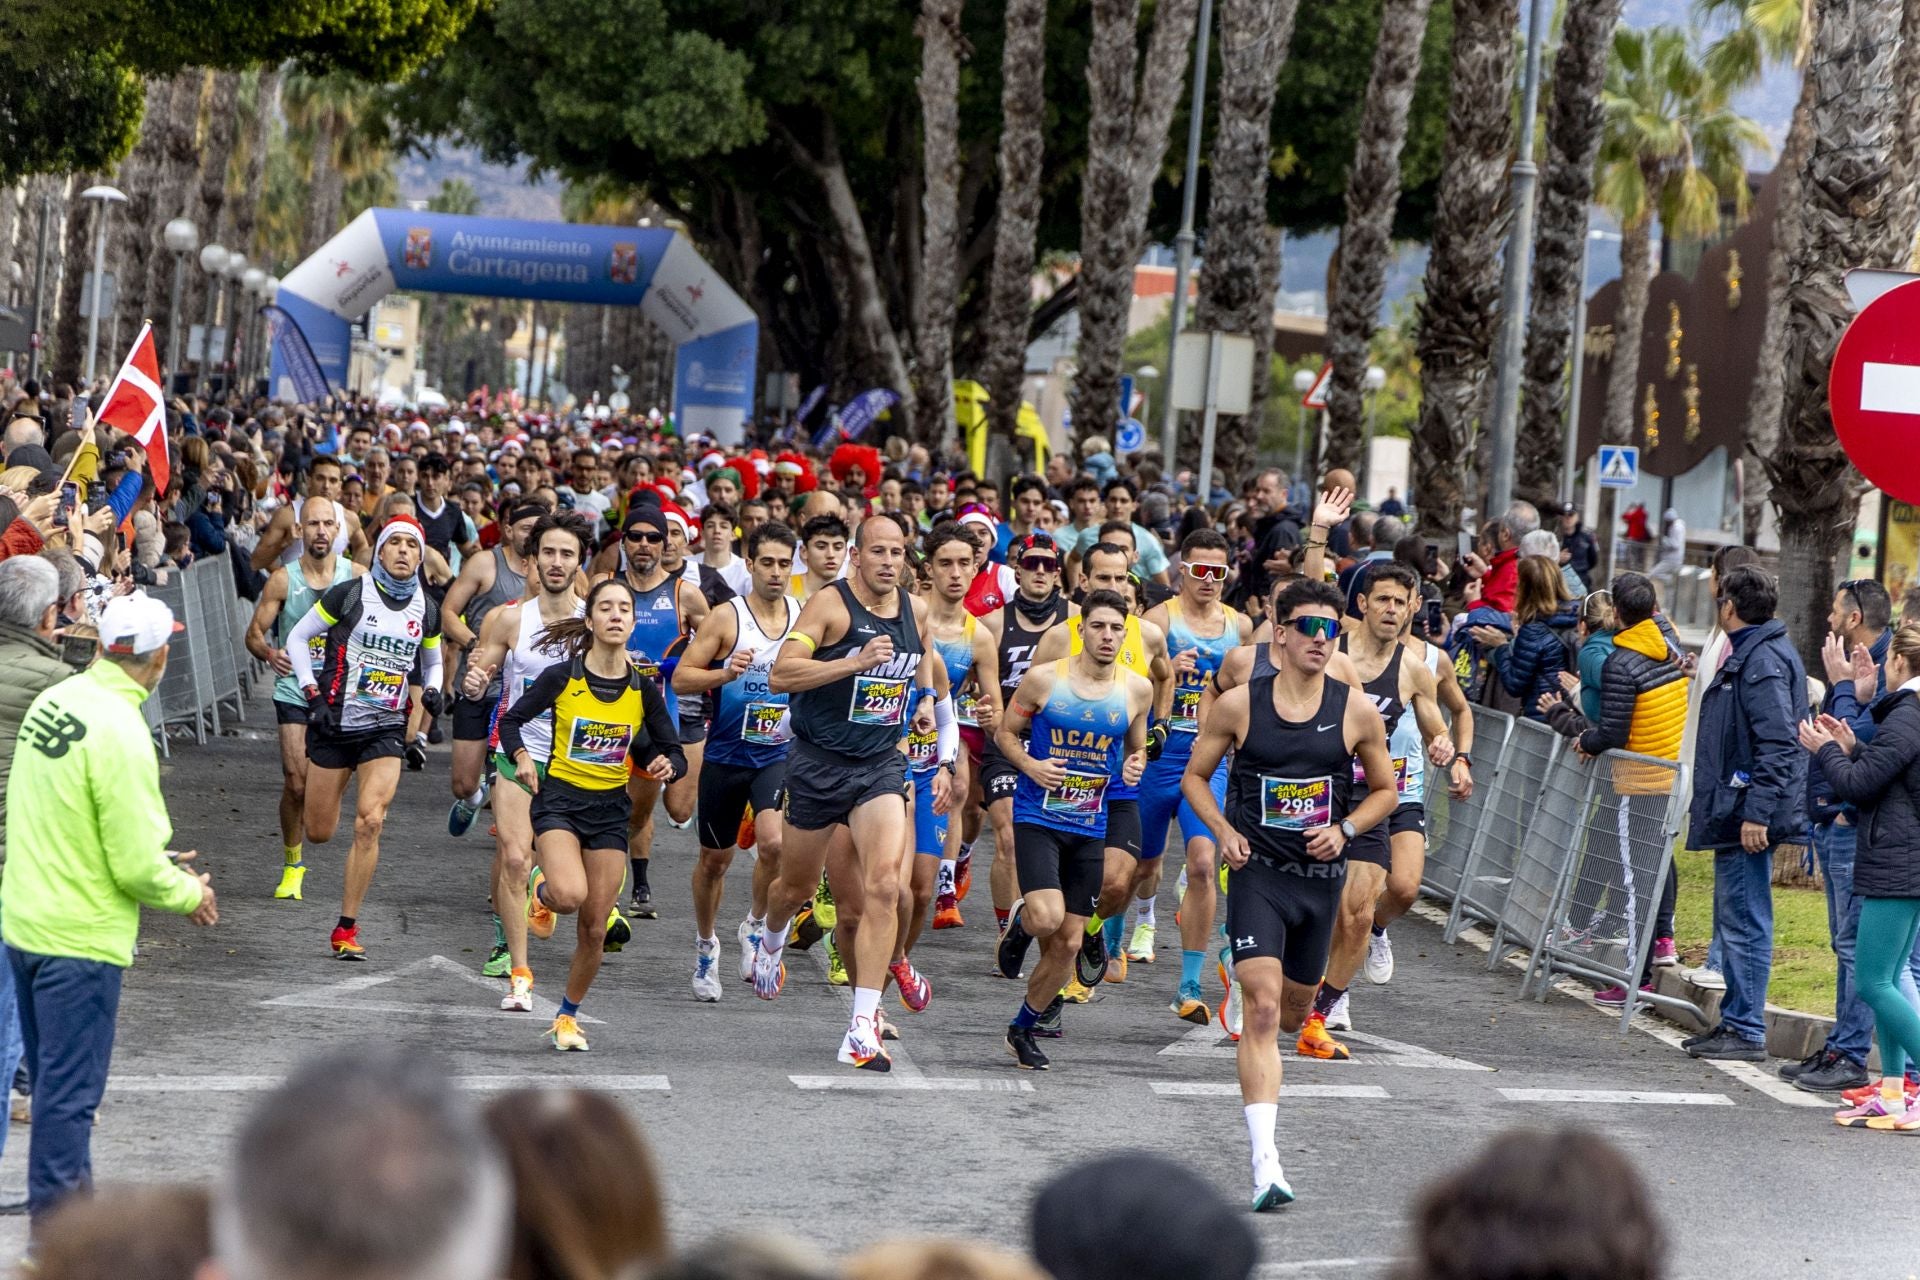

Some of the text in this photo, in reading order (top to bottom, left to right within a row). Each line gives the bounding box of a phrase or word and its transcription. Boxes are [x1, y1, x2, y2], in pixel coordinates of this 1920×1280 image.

[451, 231, 592, 258] Ayuntamiento
[448, 248, 589, 285] Cartagena
[365, 680, 398, 698] 2442
[869, 683, 887, 691] SAN
[863, 696, 900, 712] 2268
[586, 726, 628, 736] SILVESTRE
[581, 734, 622, 752] 2727
[1051, 728, 1113, 752] UCAM
[1049, 746, 1107, 761] UNIVERSIDAD
[1060, 786, 1096, 802] 1758
[1277, 782, 1325, 799] SILVESTRE
[1280, 798, 1315, 814] 298
